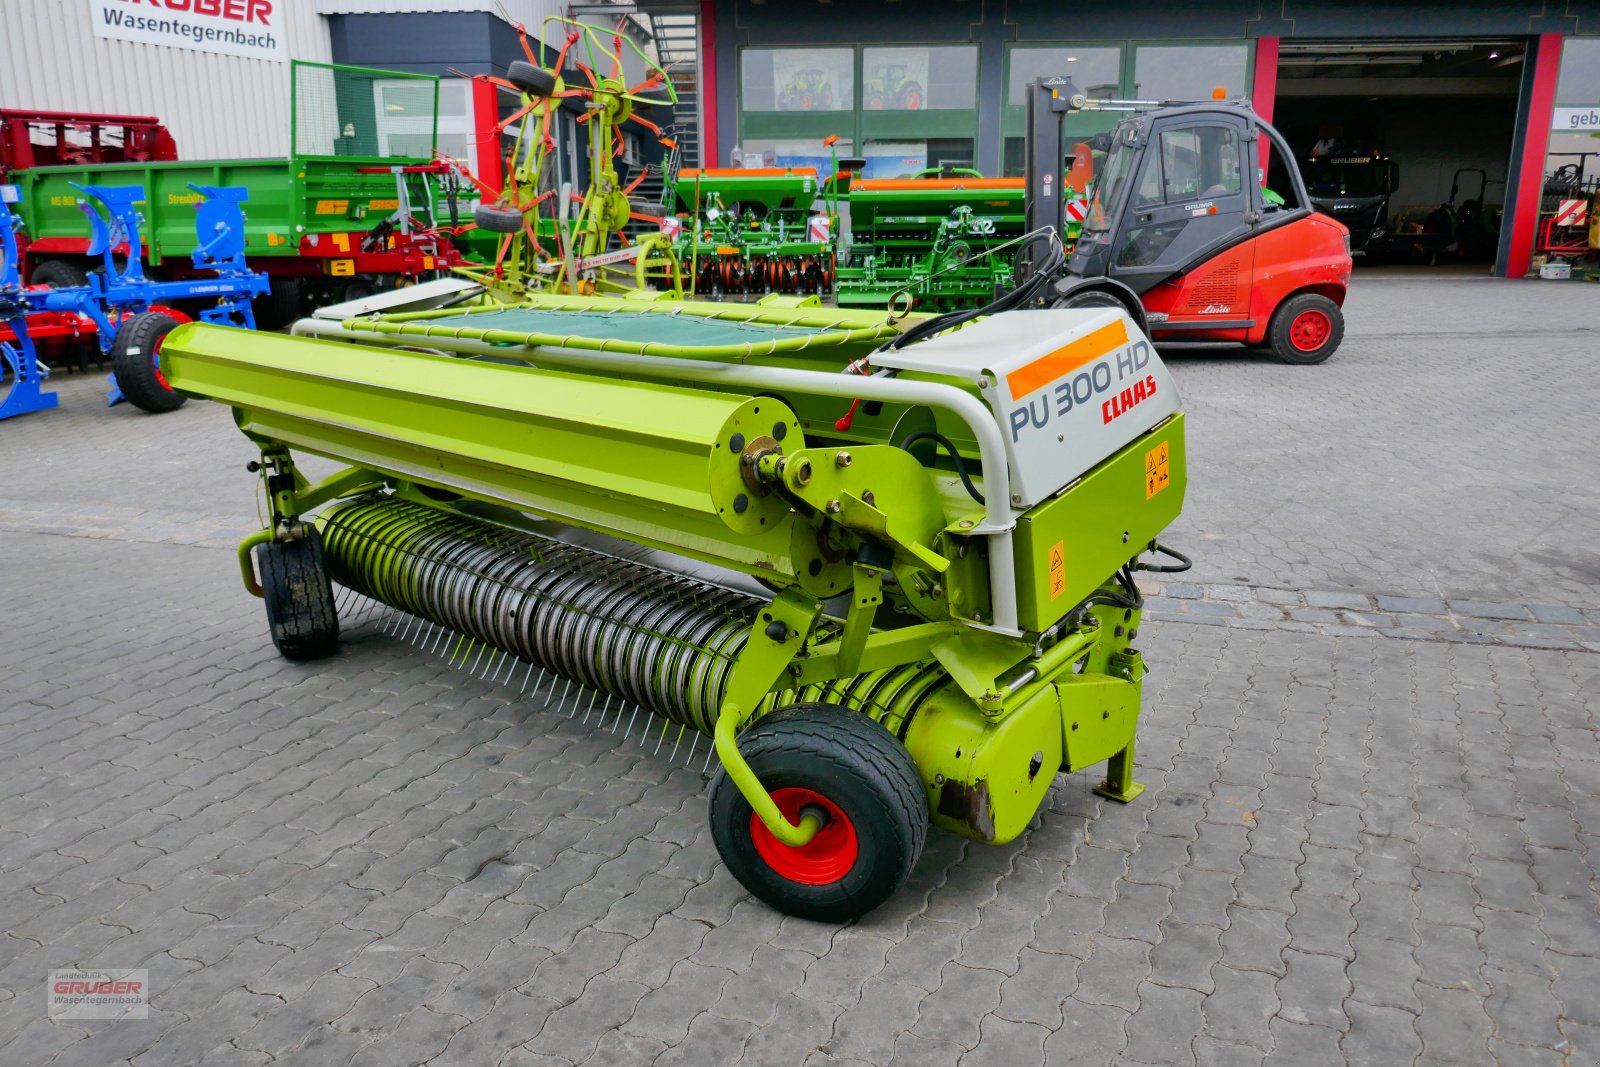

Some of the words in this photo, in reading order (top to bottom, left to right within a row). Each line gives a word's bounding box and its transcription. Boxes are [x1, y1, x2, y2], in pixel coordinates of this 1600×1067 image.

[103, 7, 276, 49] Wasentegernbach
[1570, 110, 1600, 128] geb
[1184, 201, 1213, 211] GRUMA
[1197, 304, 1231, 315] Linde
[1009, 394, 1050, 444] PU
[1054, 361, 1112, 417] 300
[1116, 340, 1150, 381] HD
[1101, 375, 1157, 425] CLAAS
